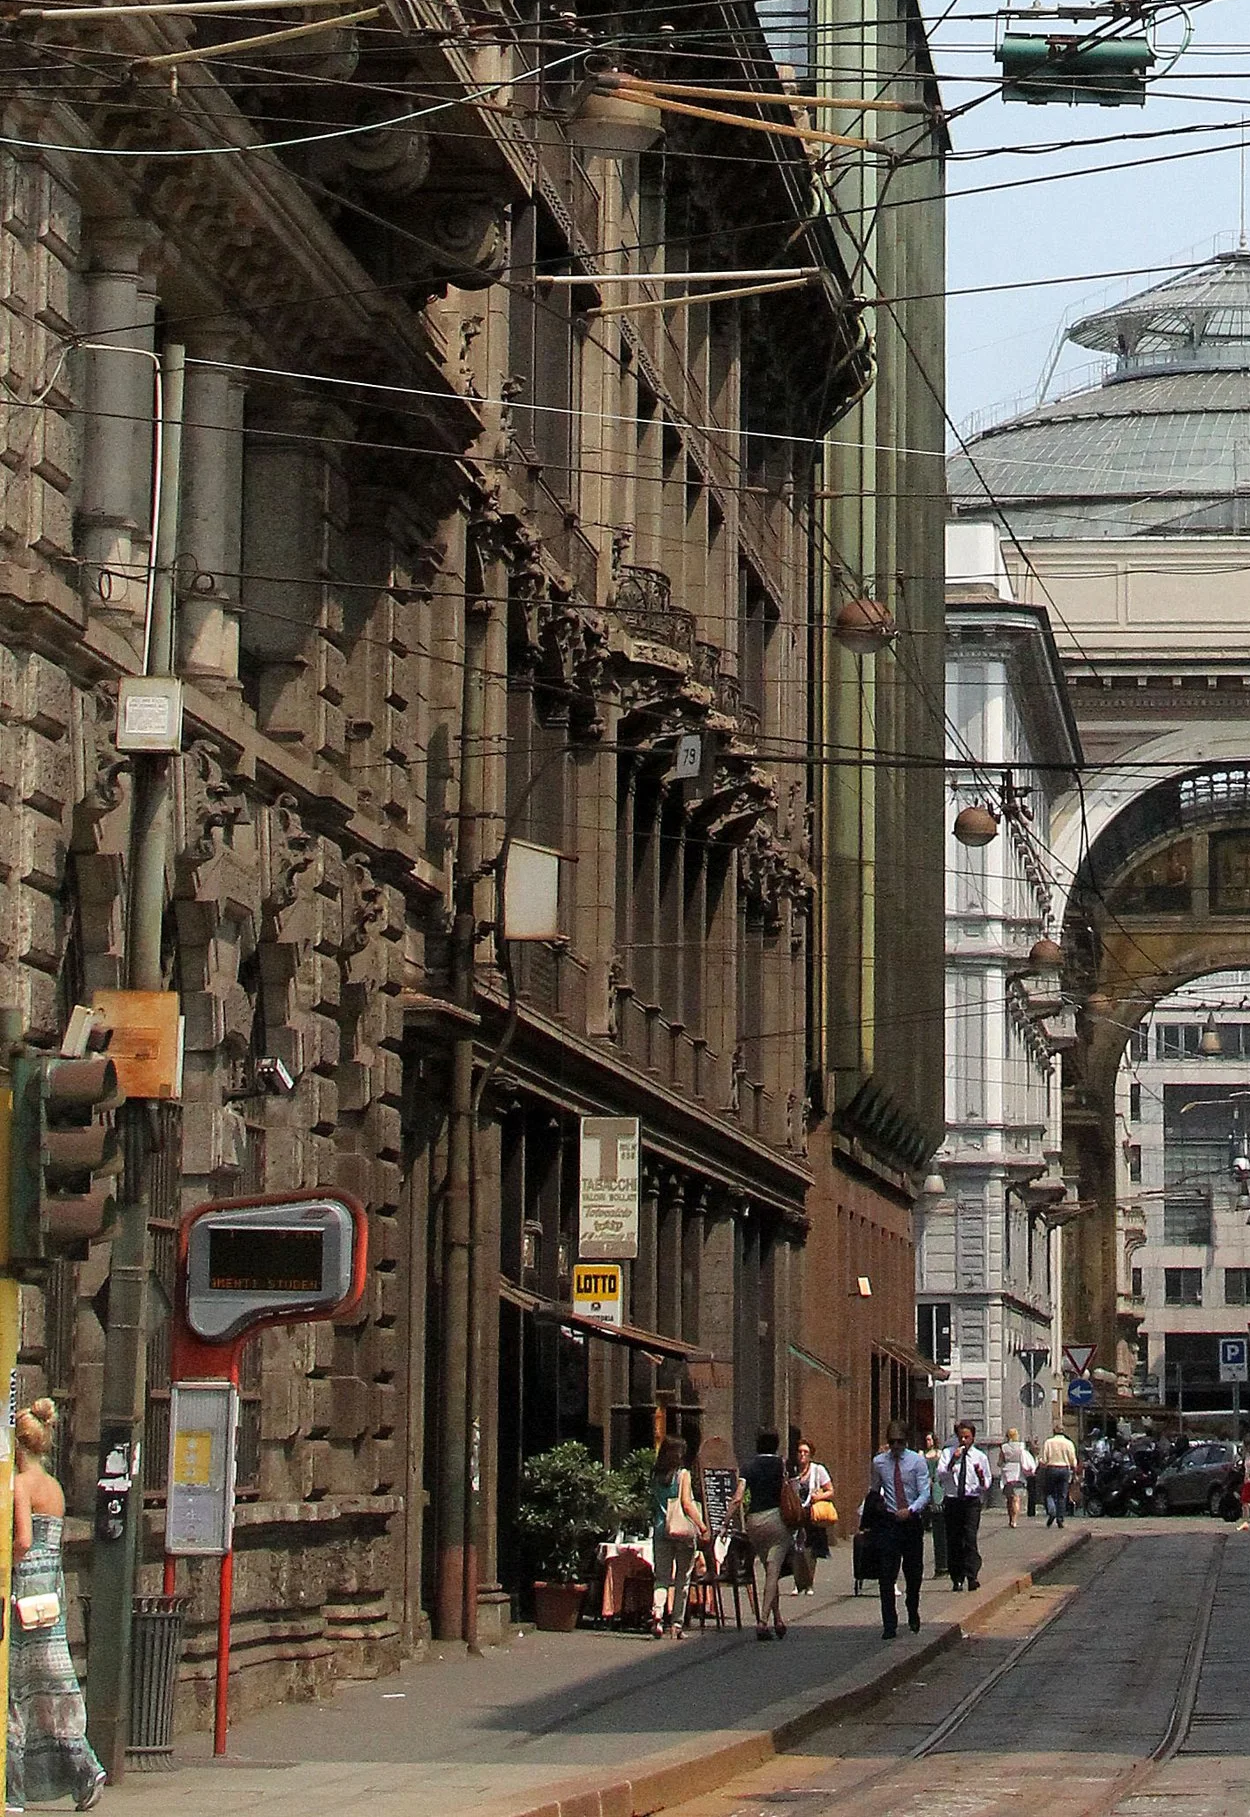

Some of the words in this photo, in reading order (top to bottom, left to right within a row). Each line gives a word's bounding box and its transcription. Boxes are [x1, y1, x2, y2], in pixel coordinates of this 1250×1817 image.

[683, 748, 696, 765] 79
[582, 1178, 637, 1192] TABACCHI
[576, 1274, 617, 1294] LOTTO
[1227, 1344, 1240, 1362] P
